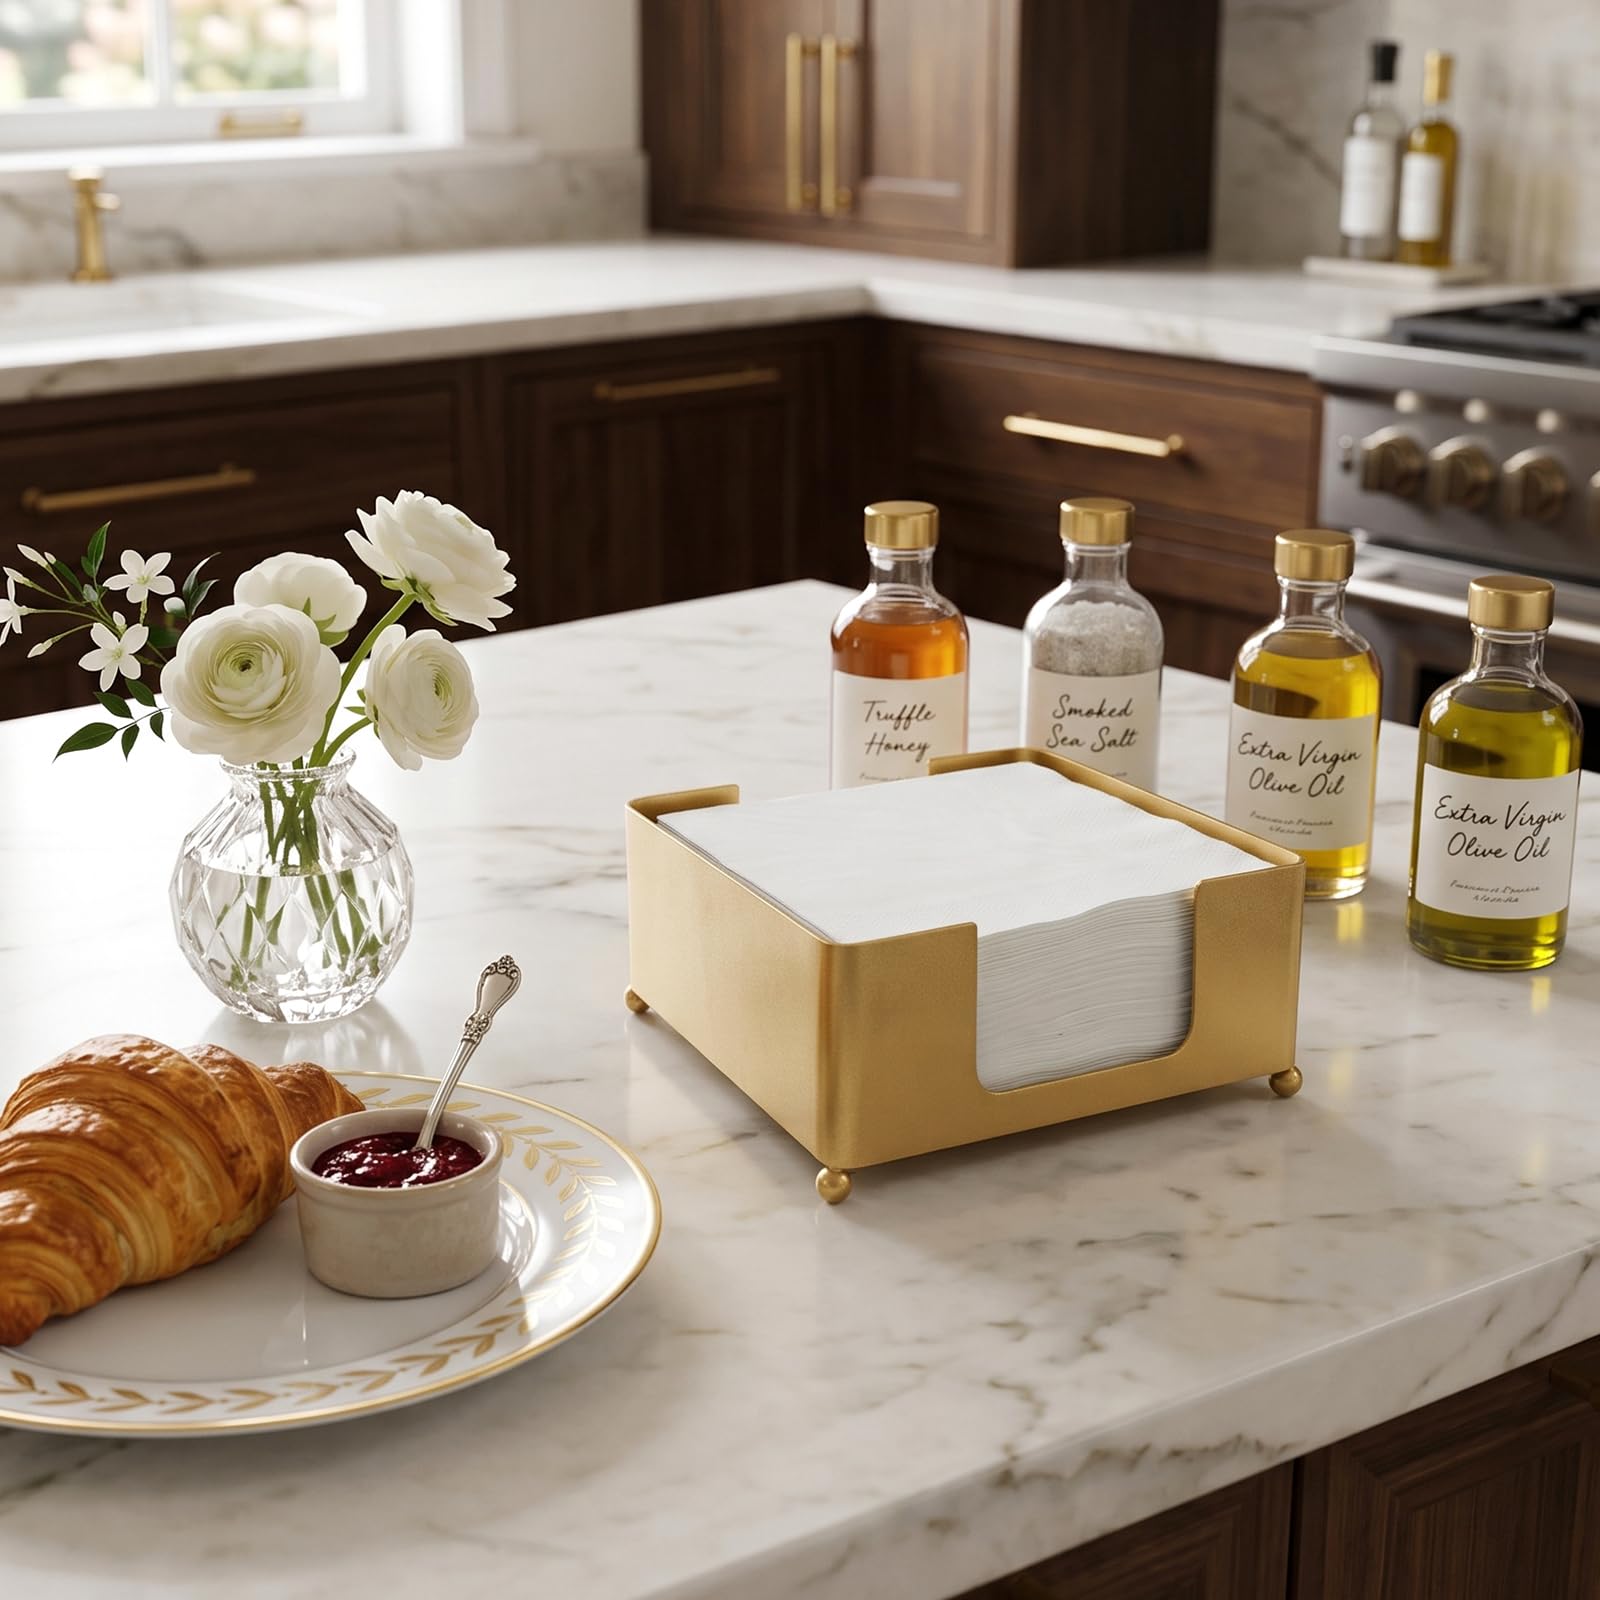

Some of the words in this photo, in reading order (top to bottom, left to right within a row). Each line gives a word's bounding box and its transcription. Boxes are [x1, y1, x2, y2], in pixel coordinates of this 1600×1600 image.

[863, 700, 936, 731] Truffle
[1052, 694, 1134, 720] Smoked
[865, 731, 931, 763] Honey
[1046, 723, 1086, 749] Sea
[1090, 726, 1139, 753] Salt
[1237, 732, 1292, 762] Extra
[1298, 740, 1361, 775] Virgin
[1249, 767, 1302, 795] Olive
[1308, 773, 1345, 798] Oil
[1434, 795, 1497, 826] Extra
[1504, 801, 1566, 837] Virgin
[1447, 831, 1508, 859] Olive
[1514, 835, 1551, 862] Oil
